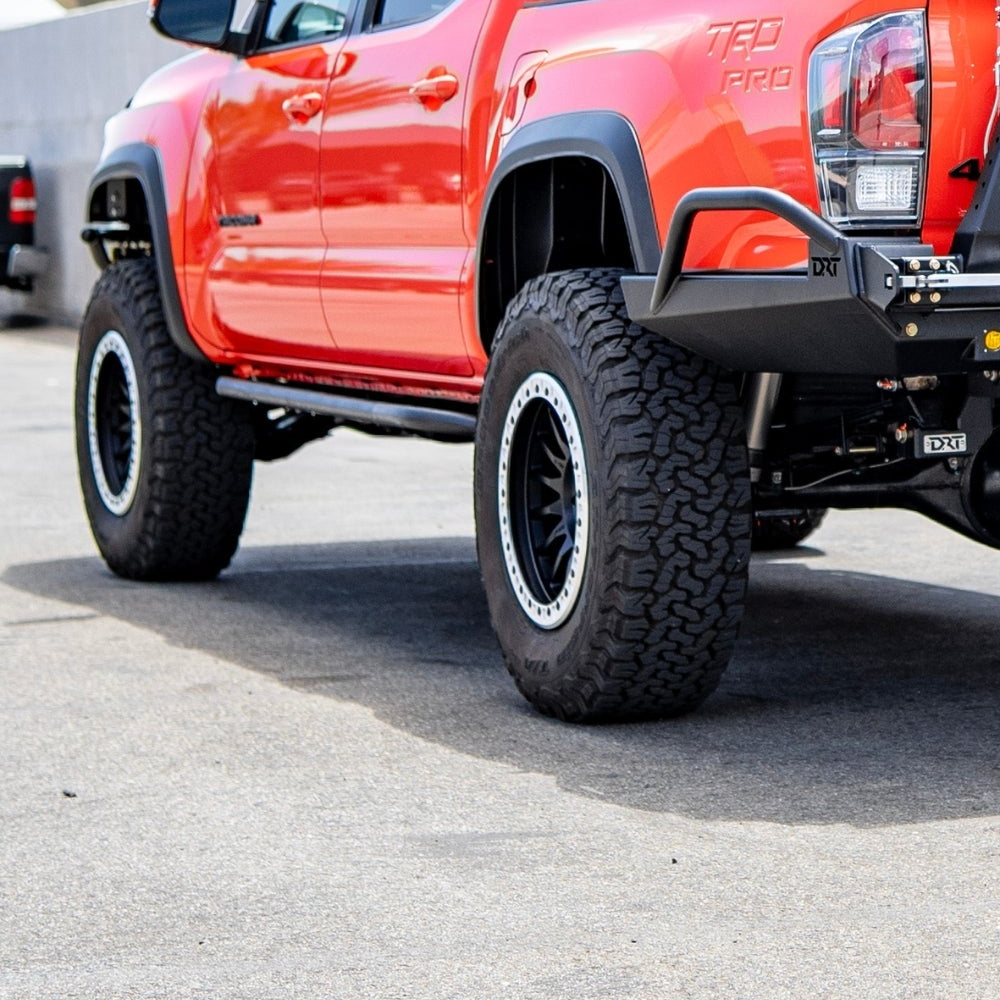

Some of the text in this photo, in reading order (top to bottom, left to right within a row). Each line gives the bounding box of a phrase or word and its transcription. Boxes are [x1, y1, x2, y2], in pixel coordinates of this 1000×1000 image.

[706, 17, 785, 64] TRD
[720, 66, 794, 95] PRO
[811, 256, 841, 277] DRT
[929, 435, 965, 451] DRT
